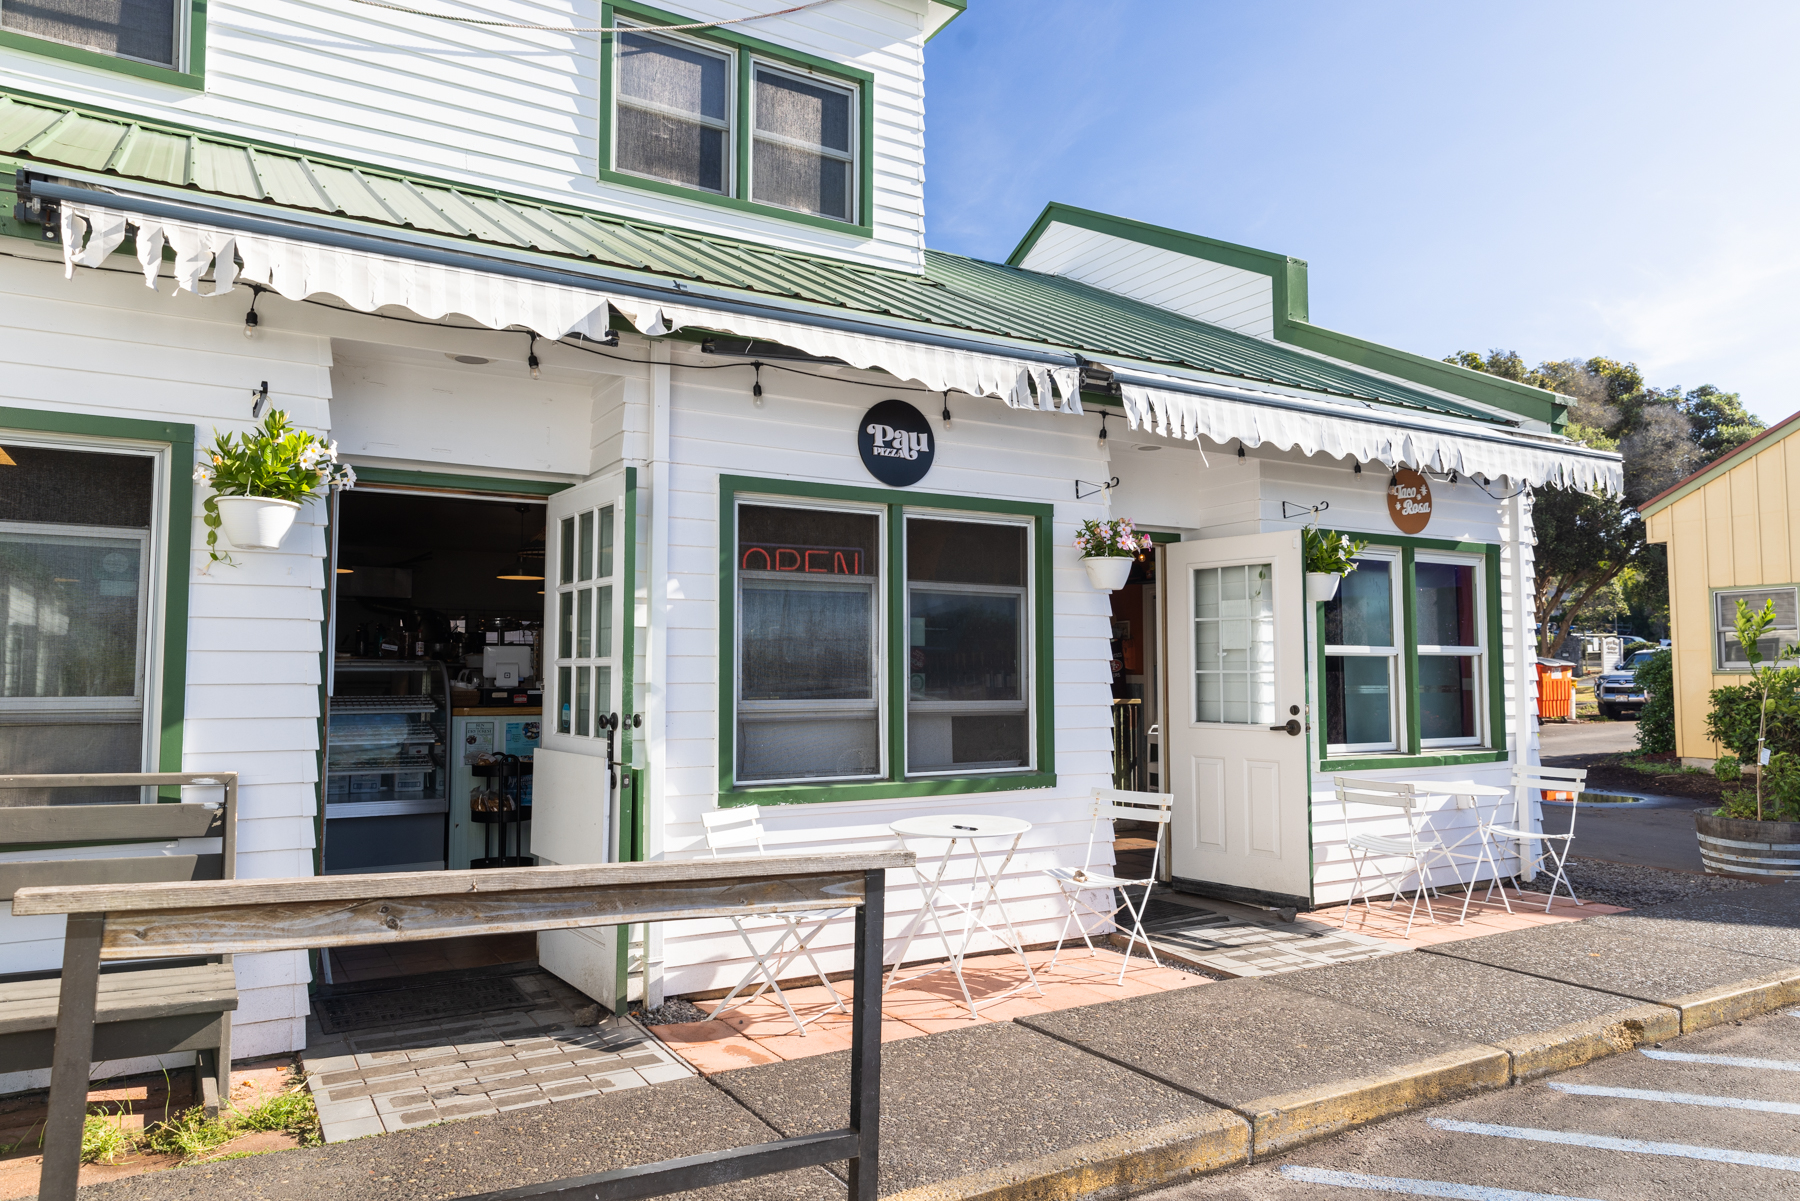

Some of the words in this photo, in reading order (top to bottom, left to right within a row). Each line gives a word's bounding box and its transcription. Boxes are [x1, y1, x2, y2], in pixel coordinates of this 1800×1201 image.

[866, 423, 929, 460] Pau
[872, 446, 905, 458] PIZZA
[1393, 484, 1416, 499] Taco
[1402, 499, 1431, 515] Rosa
